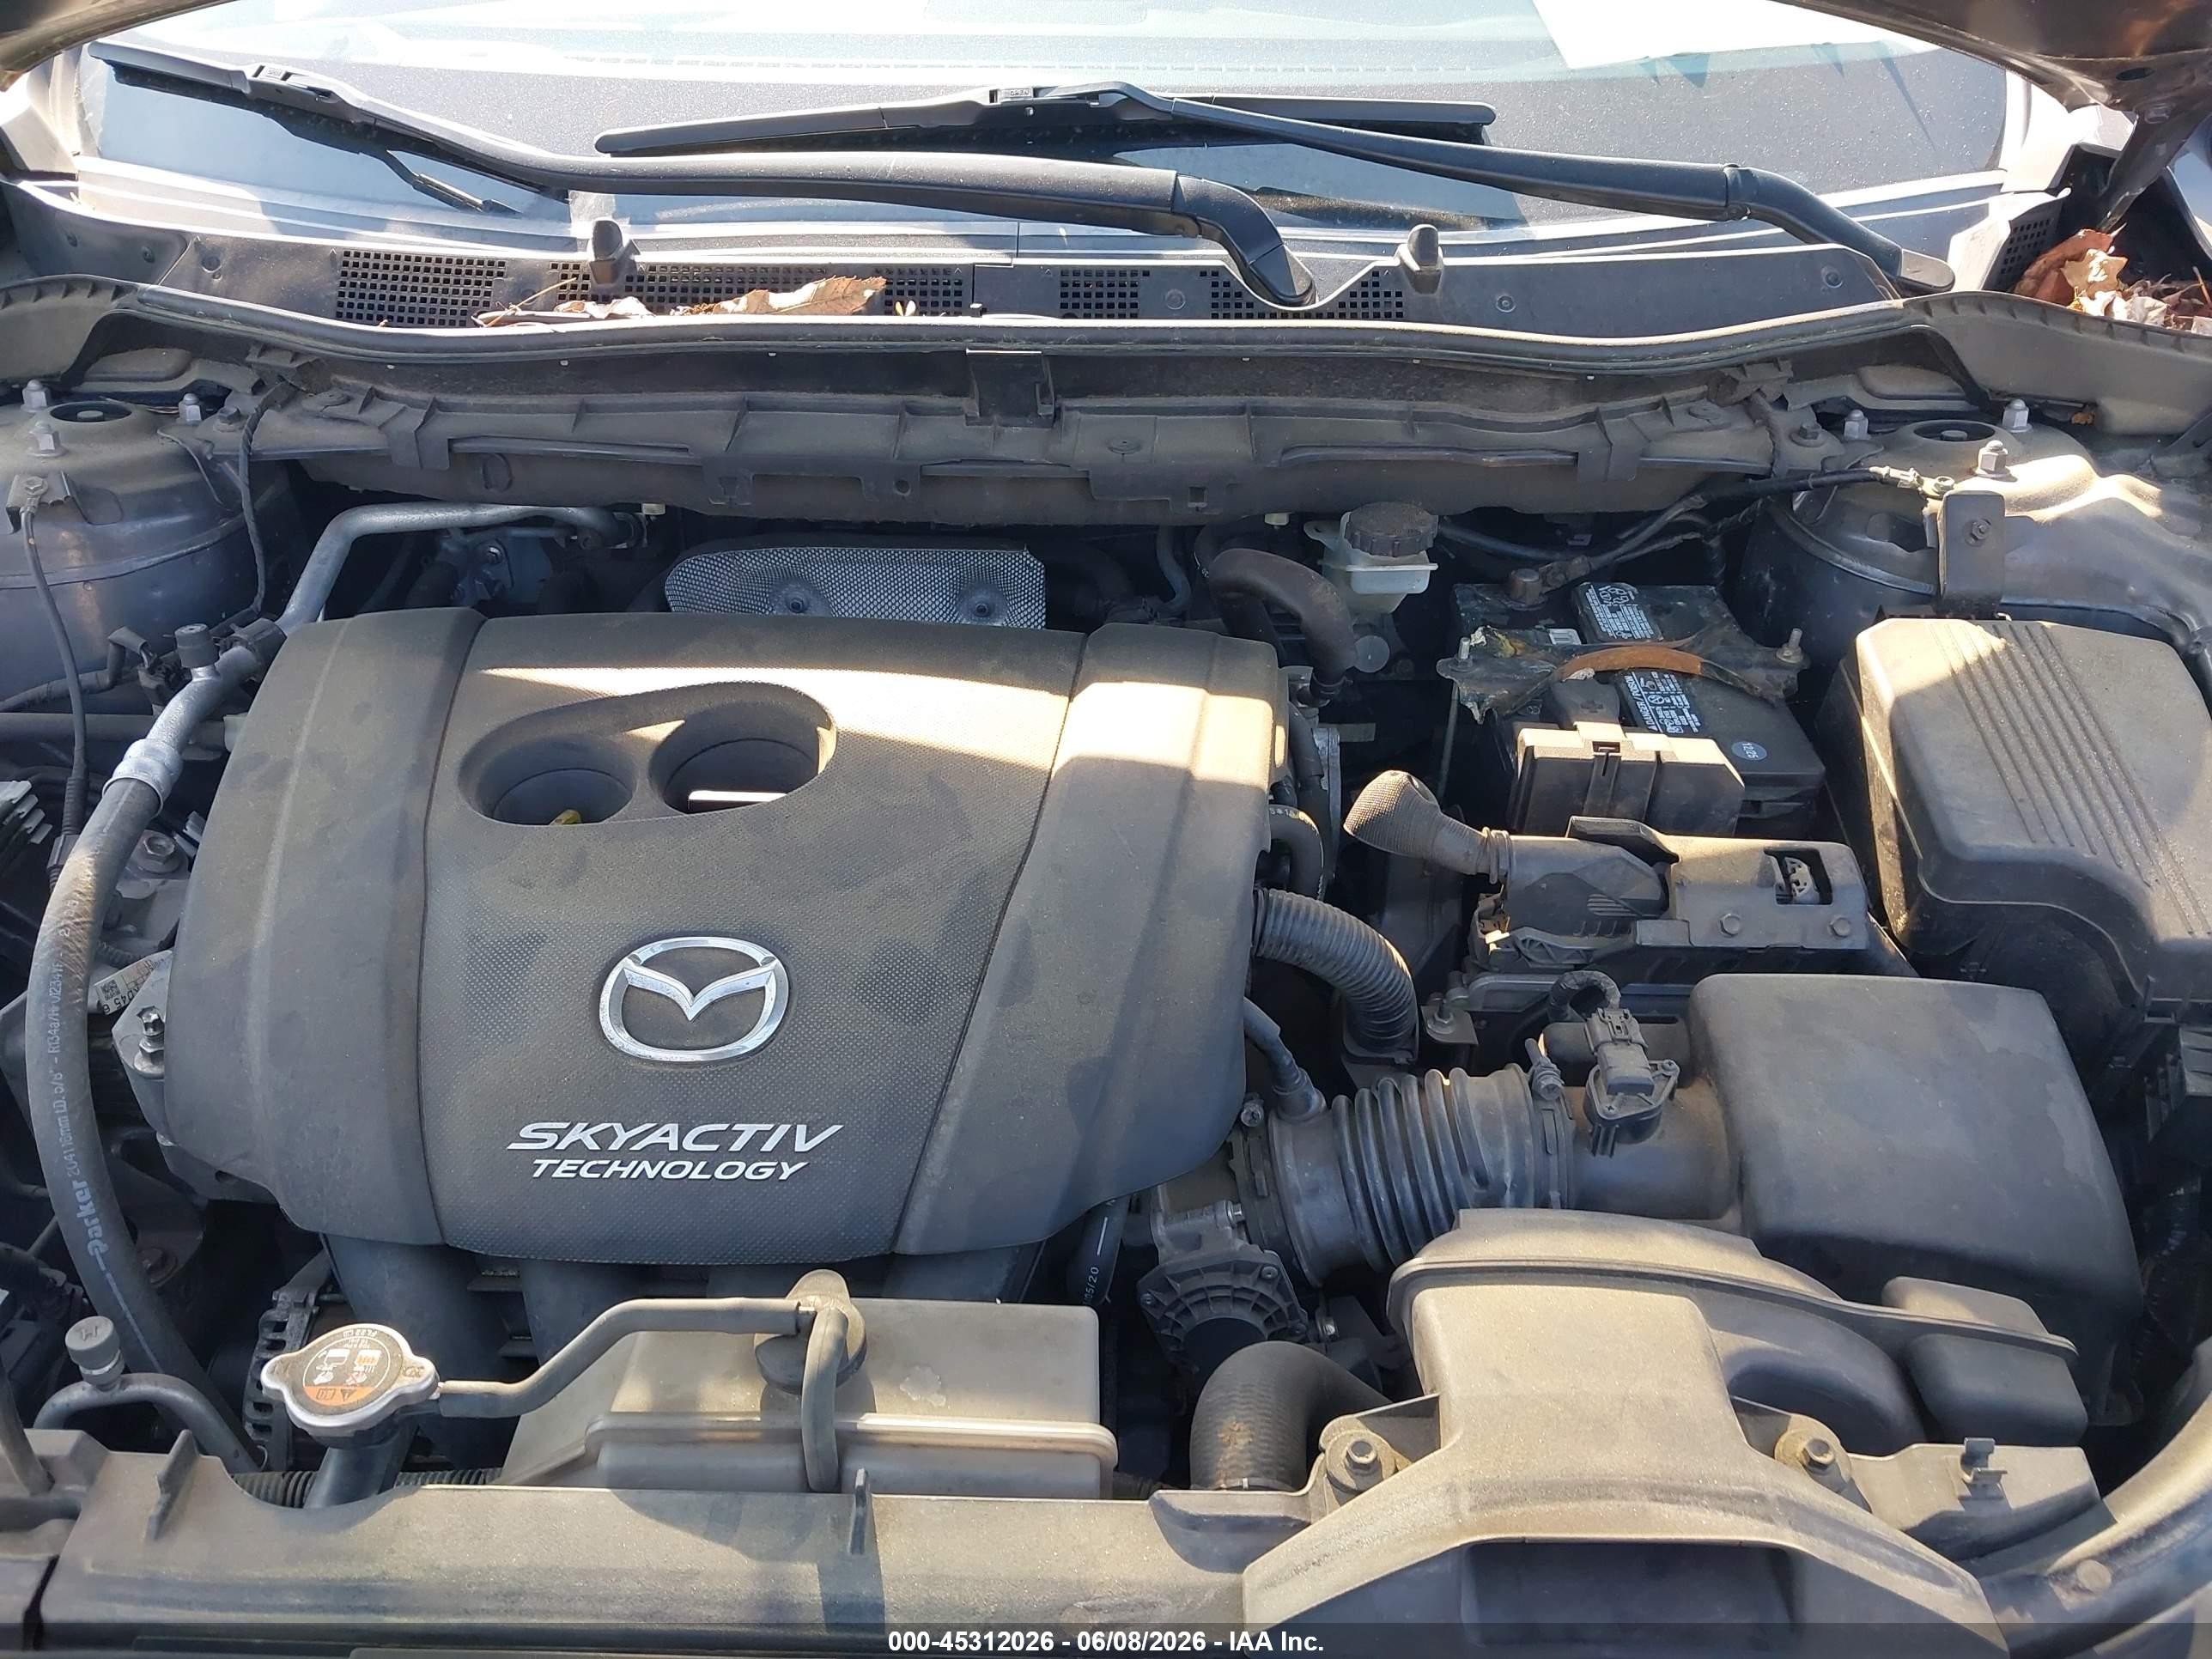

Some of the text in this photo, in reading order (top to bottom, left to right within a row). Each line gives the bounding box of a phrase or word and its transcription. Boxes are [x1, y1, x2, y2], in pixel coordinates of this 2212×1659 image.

[507, 1121, 844, 1152] SKYACTIV
[532, 1159, 809, 1180] TECHNOLOGY
[72, 1179, 109, 1257] Parker
